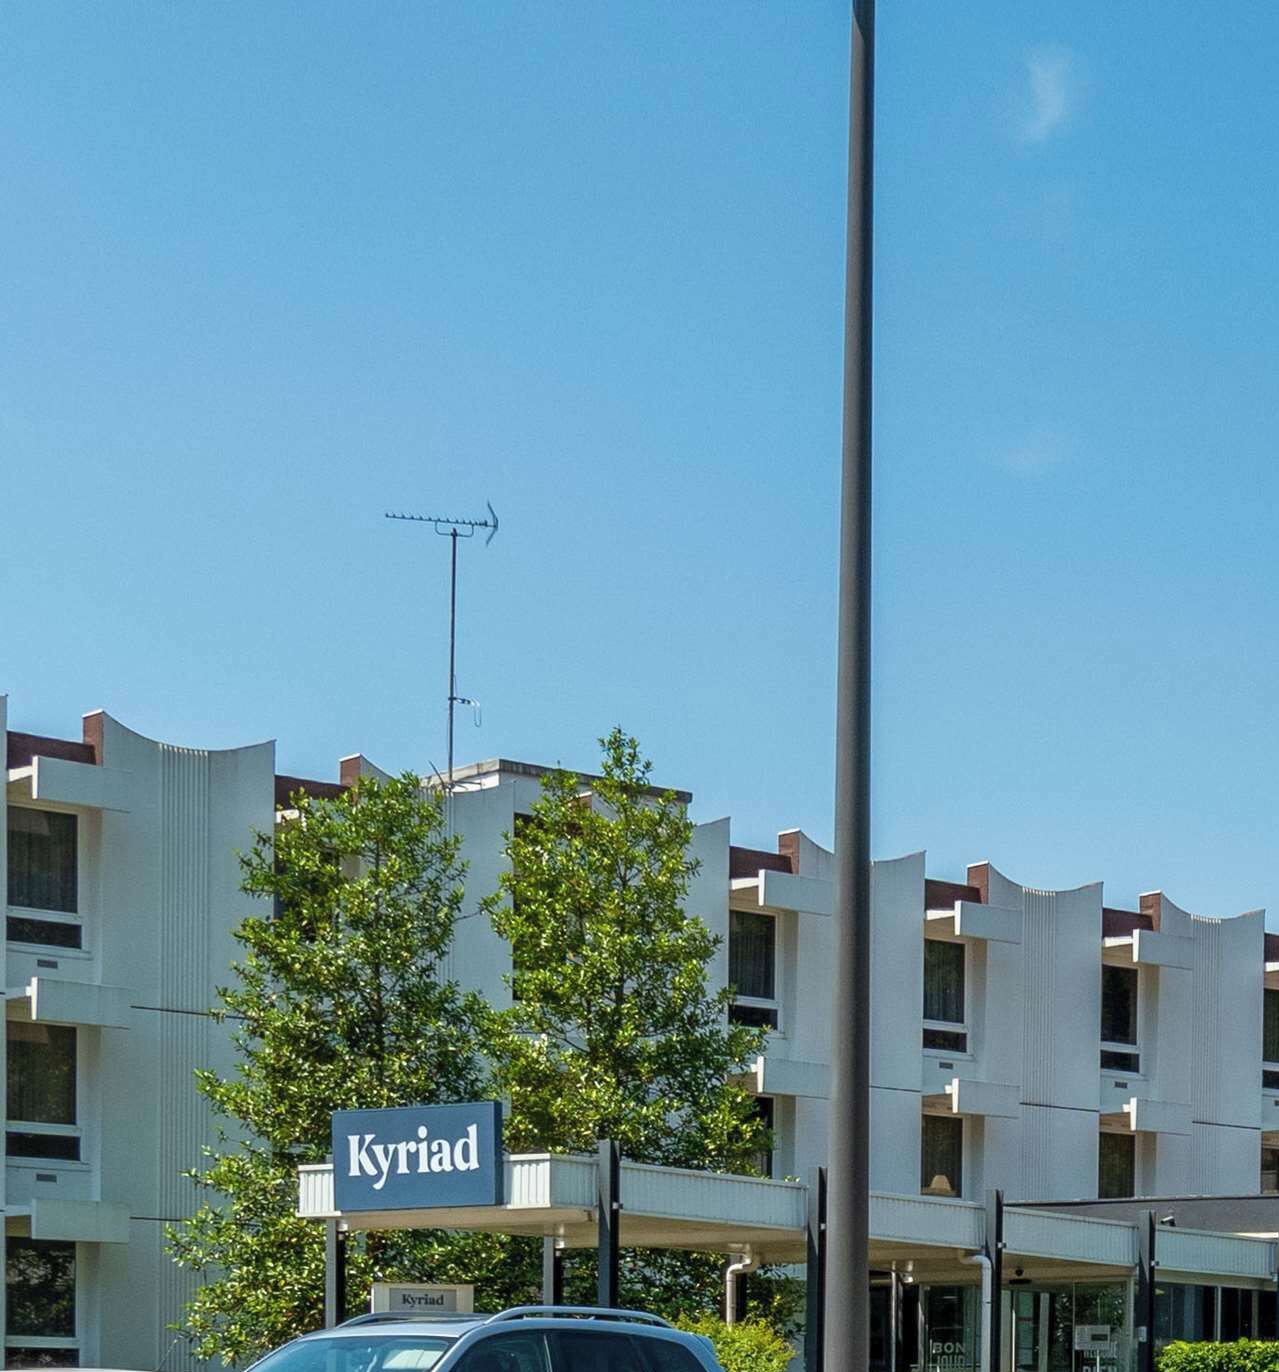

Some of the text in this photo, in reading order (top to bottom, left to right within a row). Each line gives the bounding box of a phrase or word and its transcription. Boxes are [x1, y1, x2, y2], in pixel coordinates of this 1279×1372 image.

[347, 1123, 480, 1190] Kyriad
[402, 1294, 445, 1306] Kyriad
[932, 1341, 965, 1354] BON
